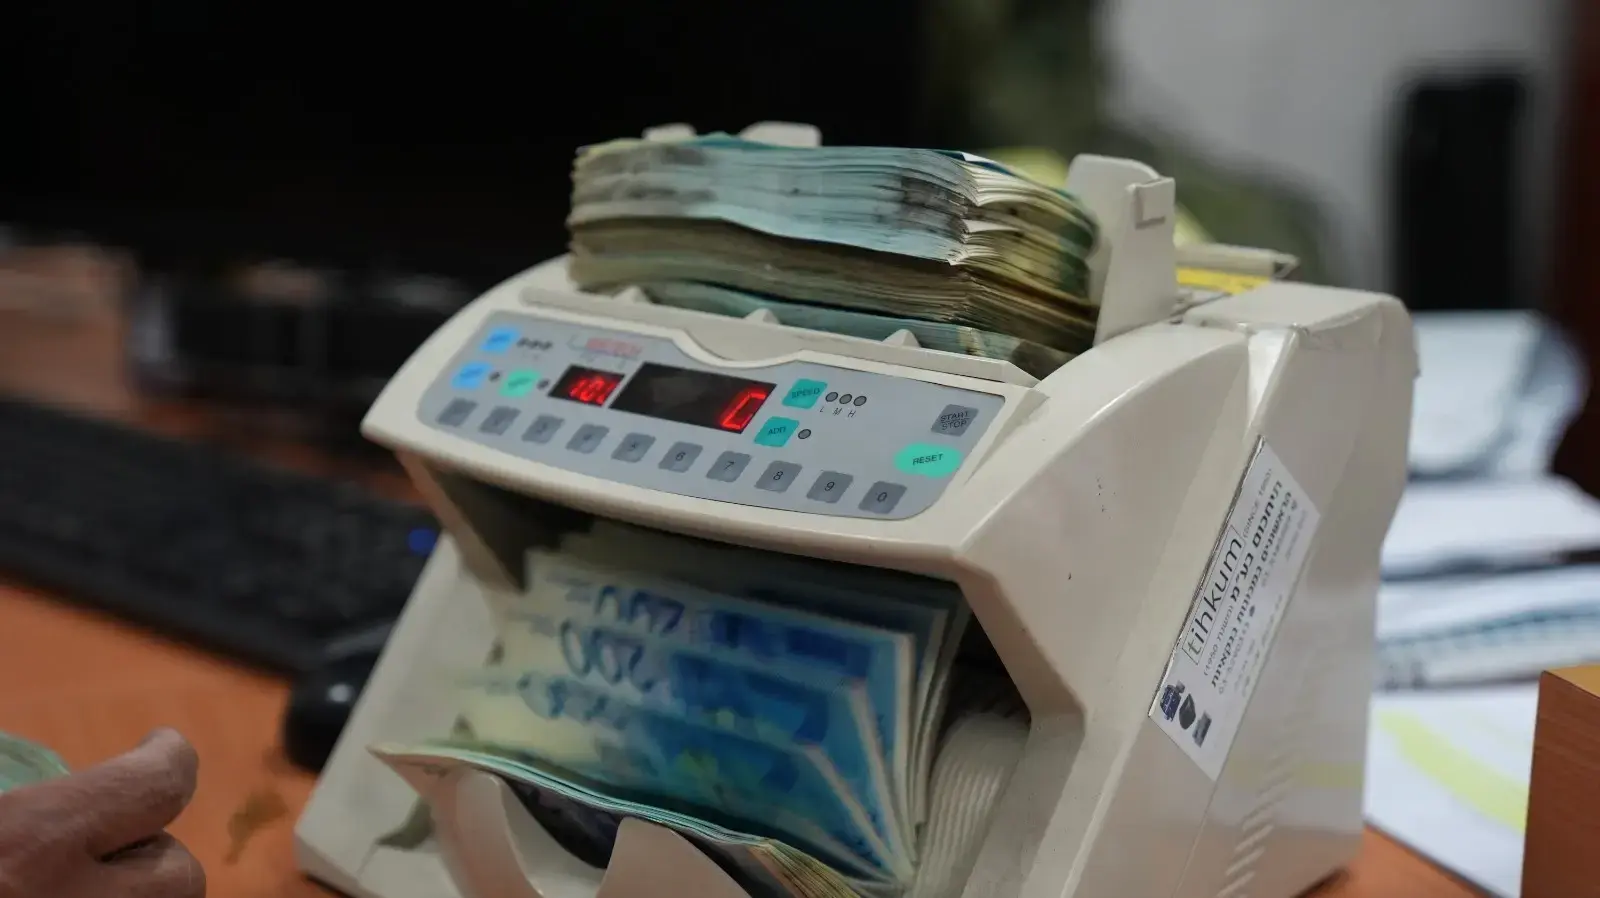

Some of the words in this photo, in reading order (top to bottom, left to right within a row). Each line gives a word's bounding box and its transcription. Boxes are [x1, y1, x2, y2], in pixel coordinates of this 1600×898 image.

[791, 387, 820, 400] SPEED
[847, 409, 857, 418] H
[940, 410, 969, 422] START
[767, 426, 787, 436] ADD
[941, 420, 968, 431] STOP
[912, 453, 944, 465] RESET
[675, 452, 686, 462] 6
[723, 461, 735, 471] 7
[773, 470, 784, 481] 8
[824, 481, 835, 492] 9
[877, 491, 887, 503] 0
[1251, 481, 1282, 549] תיחכום
[1187, 538, 1243, 655] tihkum
